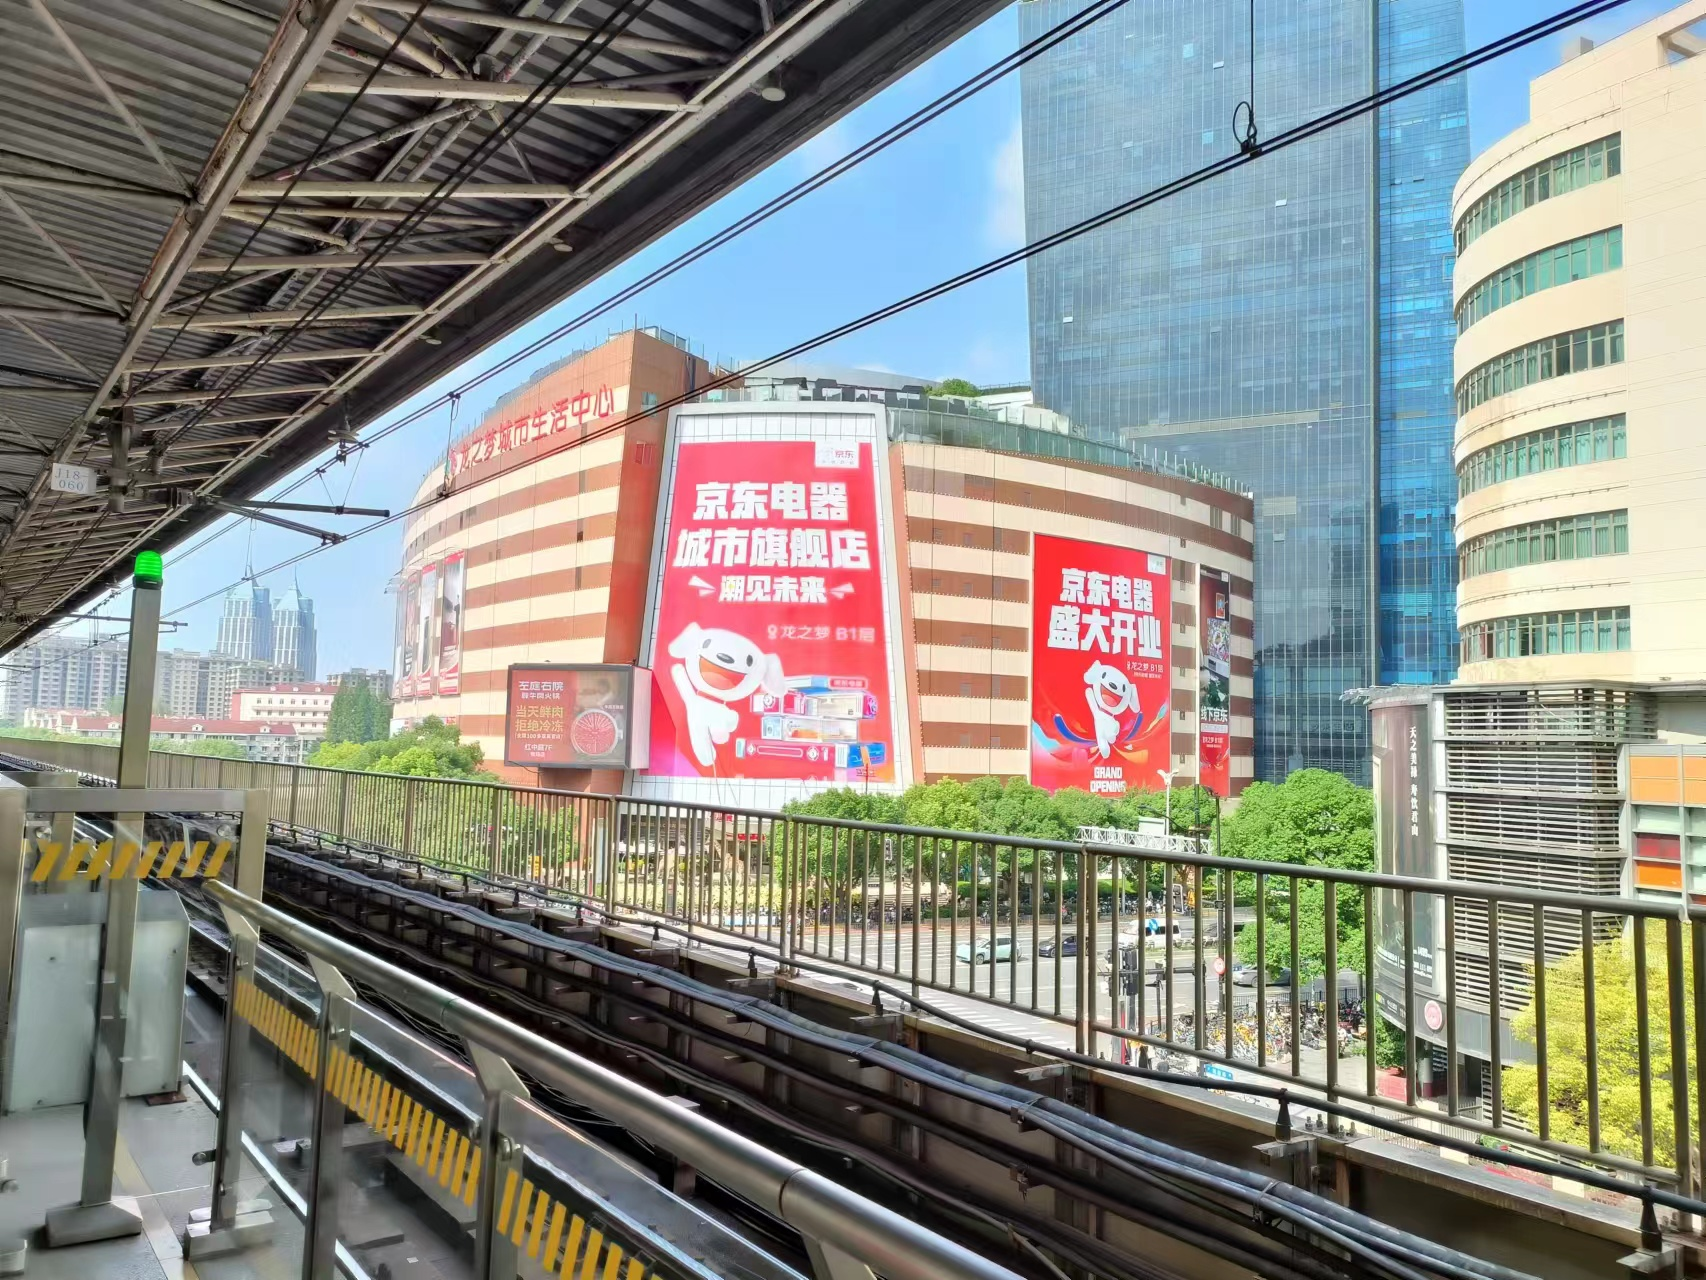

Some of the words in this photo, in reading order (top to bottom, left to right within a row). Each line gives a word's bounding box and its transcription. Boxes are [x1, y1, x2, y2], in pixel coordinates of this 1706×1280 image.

[461, 384, 614, 470] 龙之梦城市生活中心
[59, 480, 84, 491] 060
[693, 482, 848, 521] 京东电器
[673, 527, 871, 569] 城市旗舰店
[718, 575, 828, 604] 潮见未来
[1059, 567, 1153, 613] 京东电器
[780, 624, 831, 641] 龙之梦
[835, 626, 876, 642] B1层
[1047, 604, 1162, 659] 盛大开业
[515, 719, 565, 733] 拒绝冷冻
[516, 705, 564, 718] 当天鲜肉
[1094, 766, 1122, 779] GRAND
